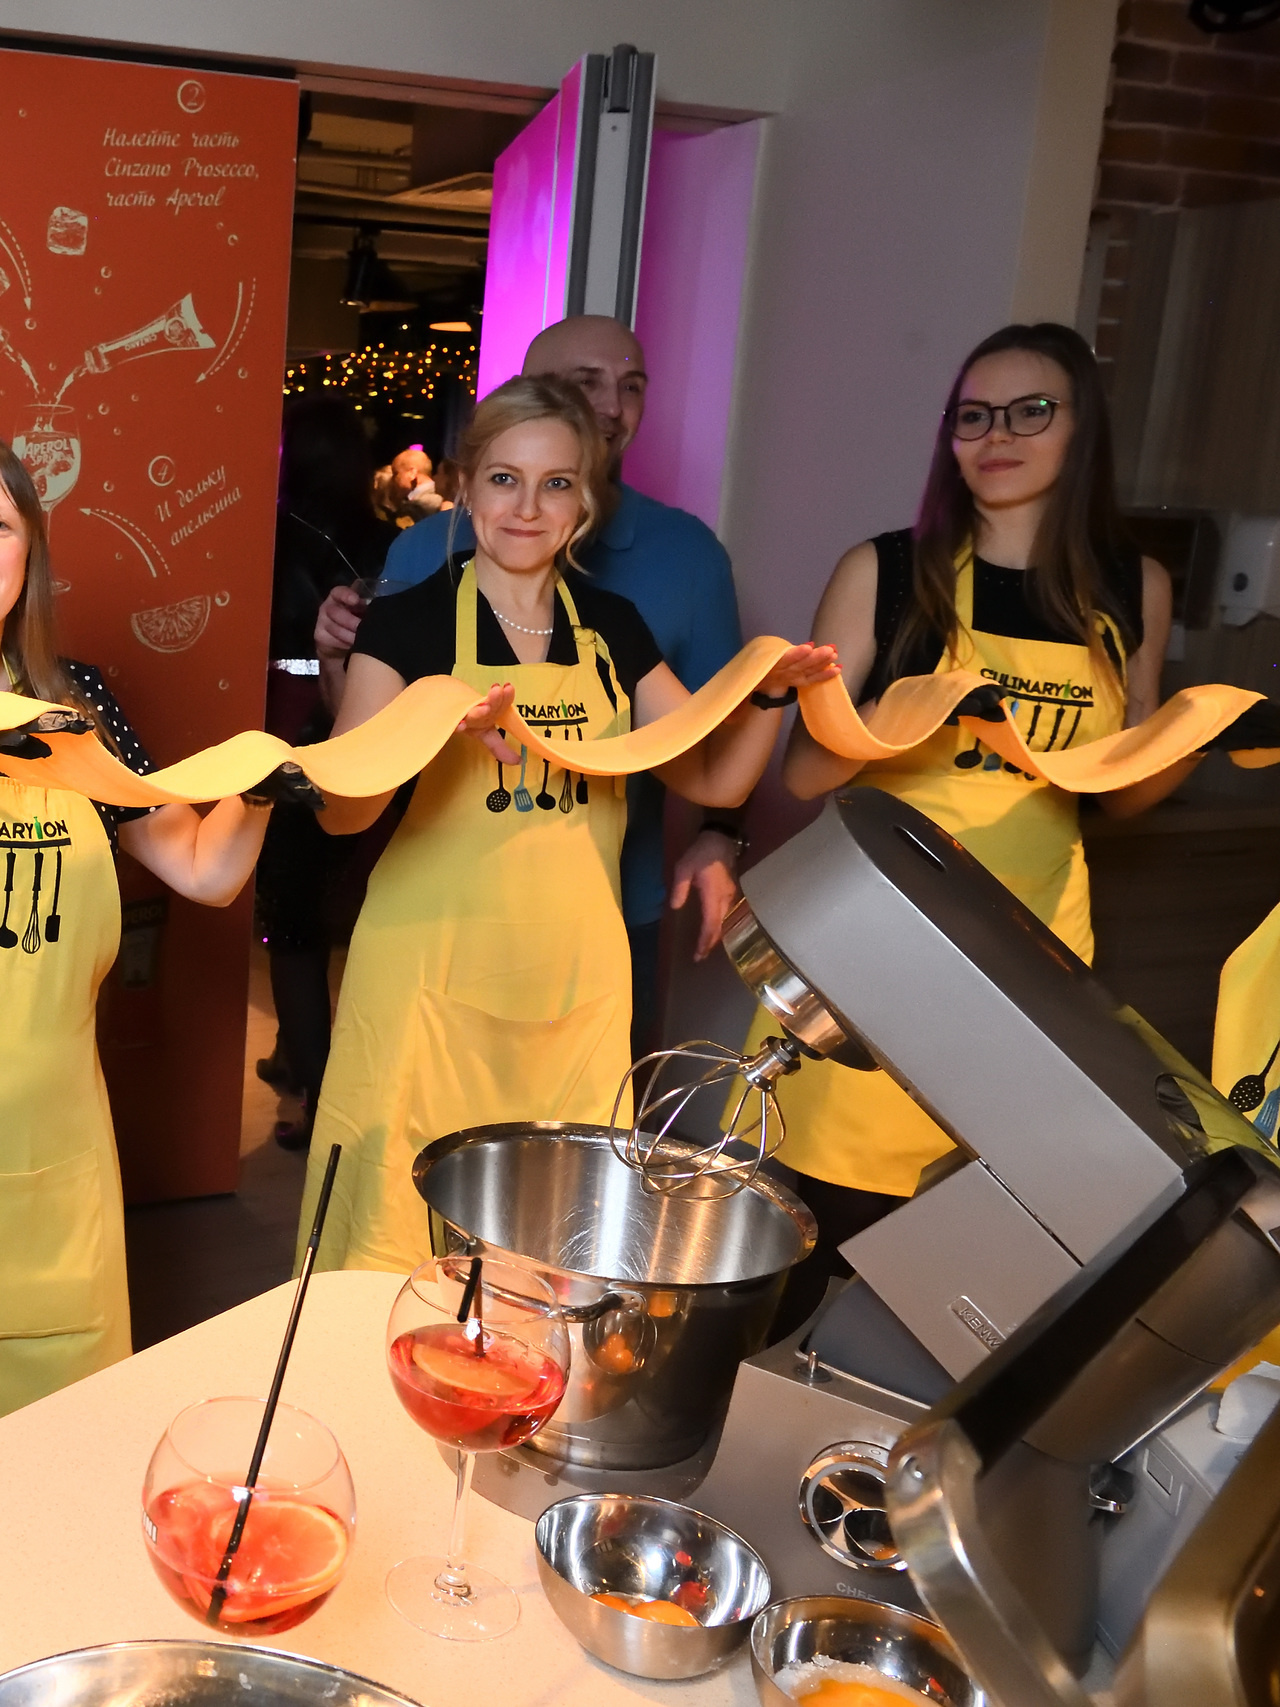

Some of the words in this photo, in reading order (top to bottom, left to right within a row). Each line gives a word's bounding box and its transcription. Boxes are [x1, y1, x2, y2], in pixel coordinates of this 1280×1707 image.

[103, 127, 181, 148] Налейте
[191, 131, 240, 148] часть
[105, 157, 171, 178] Cinzano
[183, 157, 259, 182] Prosecco,
[106, 190, 156, 207] часть
[166, 186, 226, 216] Aperol
[23, 438, 70, 459] APEROL
[155, 500, 171, 522] И
[175, 465, 226, 508] дольку
[171, 486, 241, 546] апельсина
[958, 1304, 1001, 1348] KENW
